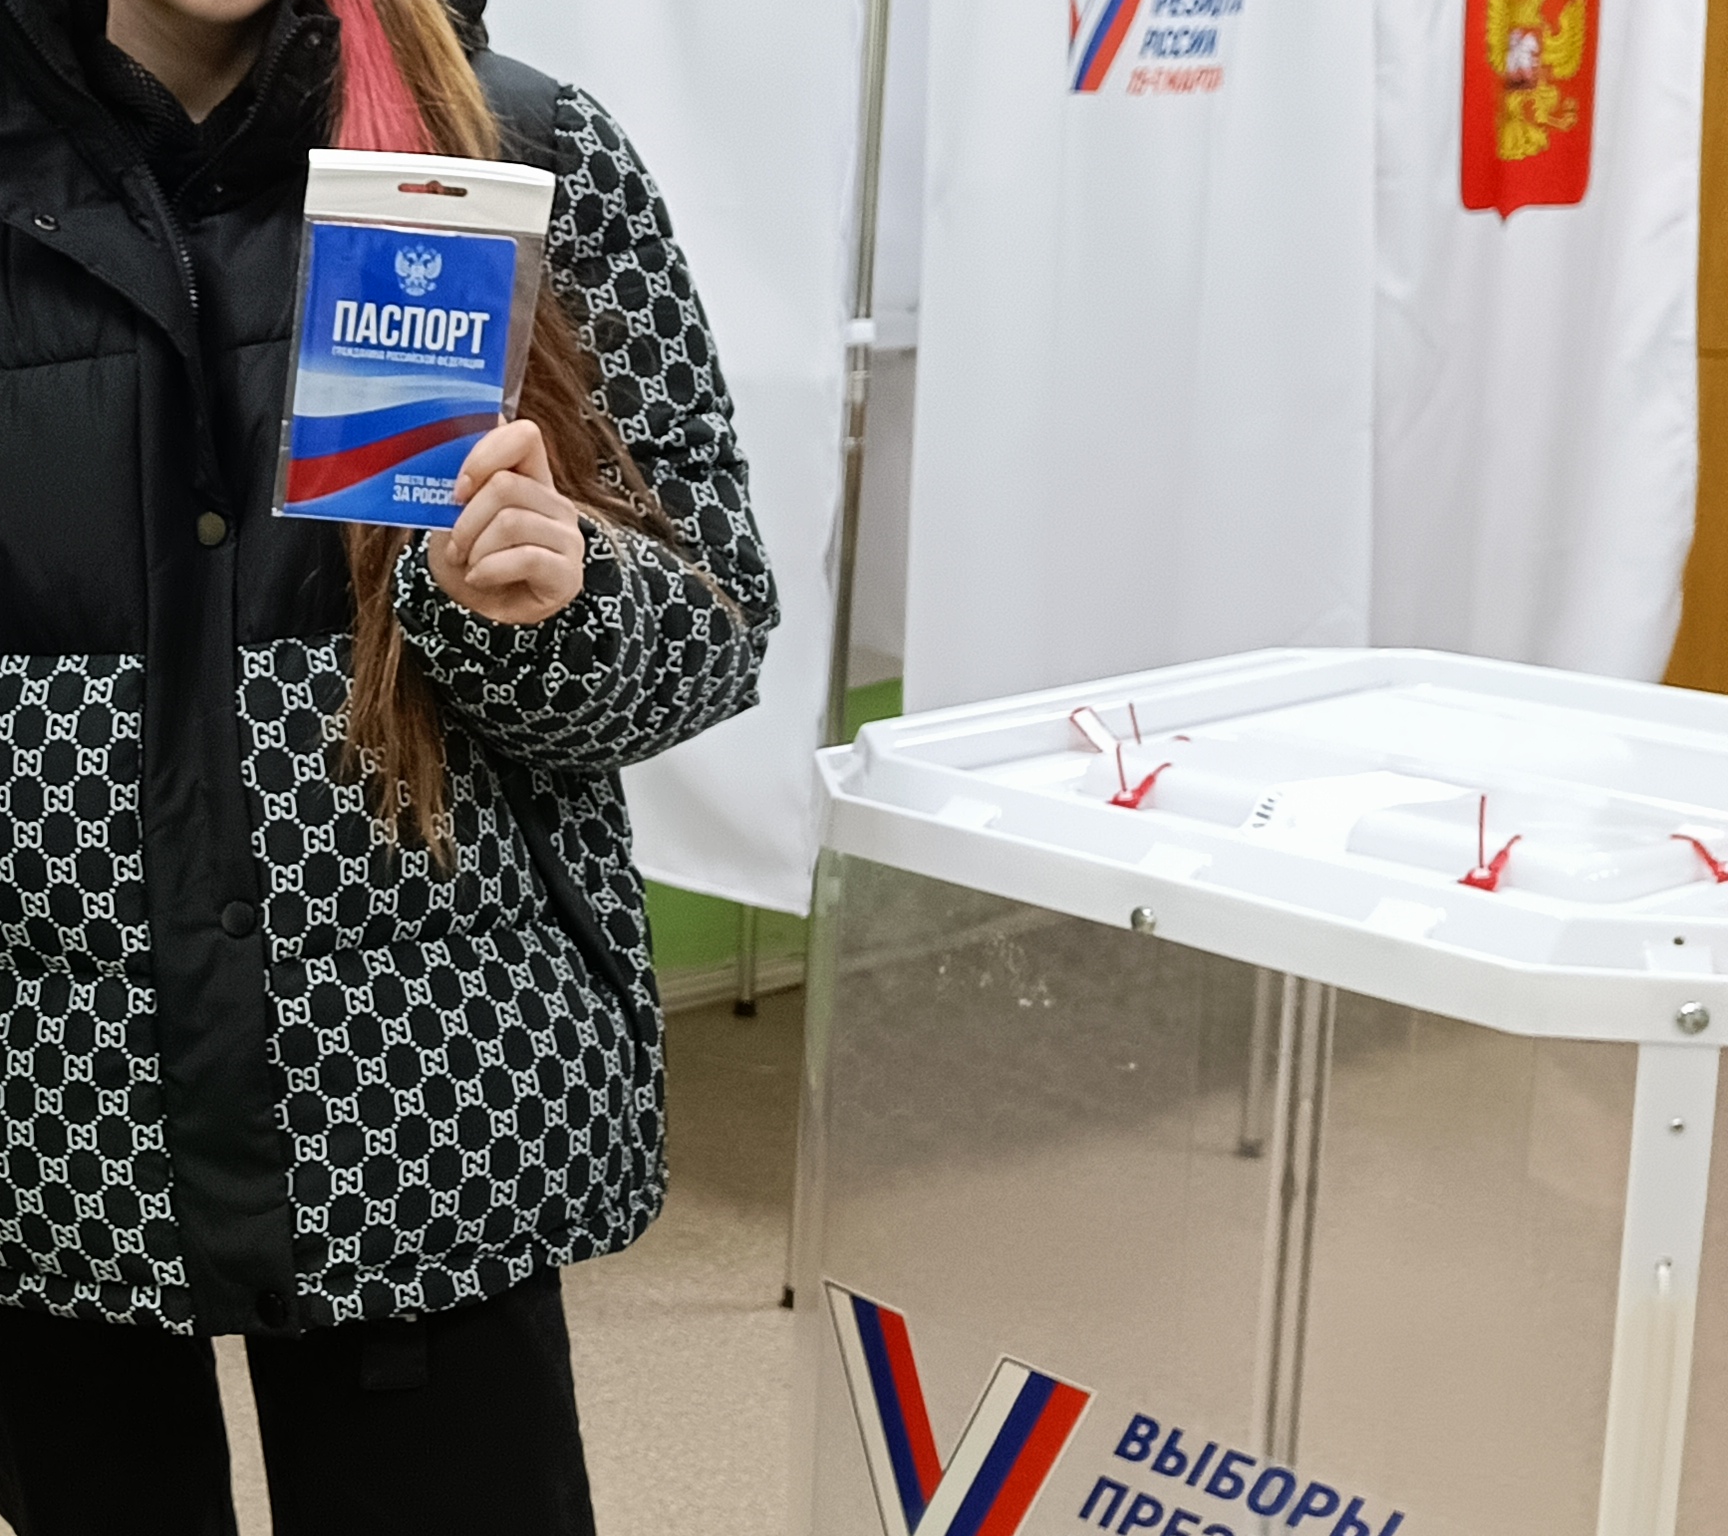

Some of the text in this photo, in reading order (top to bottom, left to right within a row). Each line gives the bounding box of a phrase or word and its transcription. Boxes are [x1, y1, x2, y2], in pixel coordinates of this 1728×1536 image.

[332, 300, 489, 353] ПАСПОРТ
[393, 485, 463, 506] ЗА РОССИ
